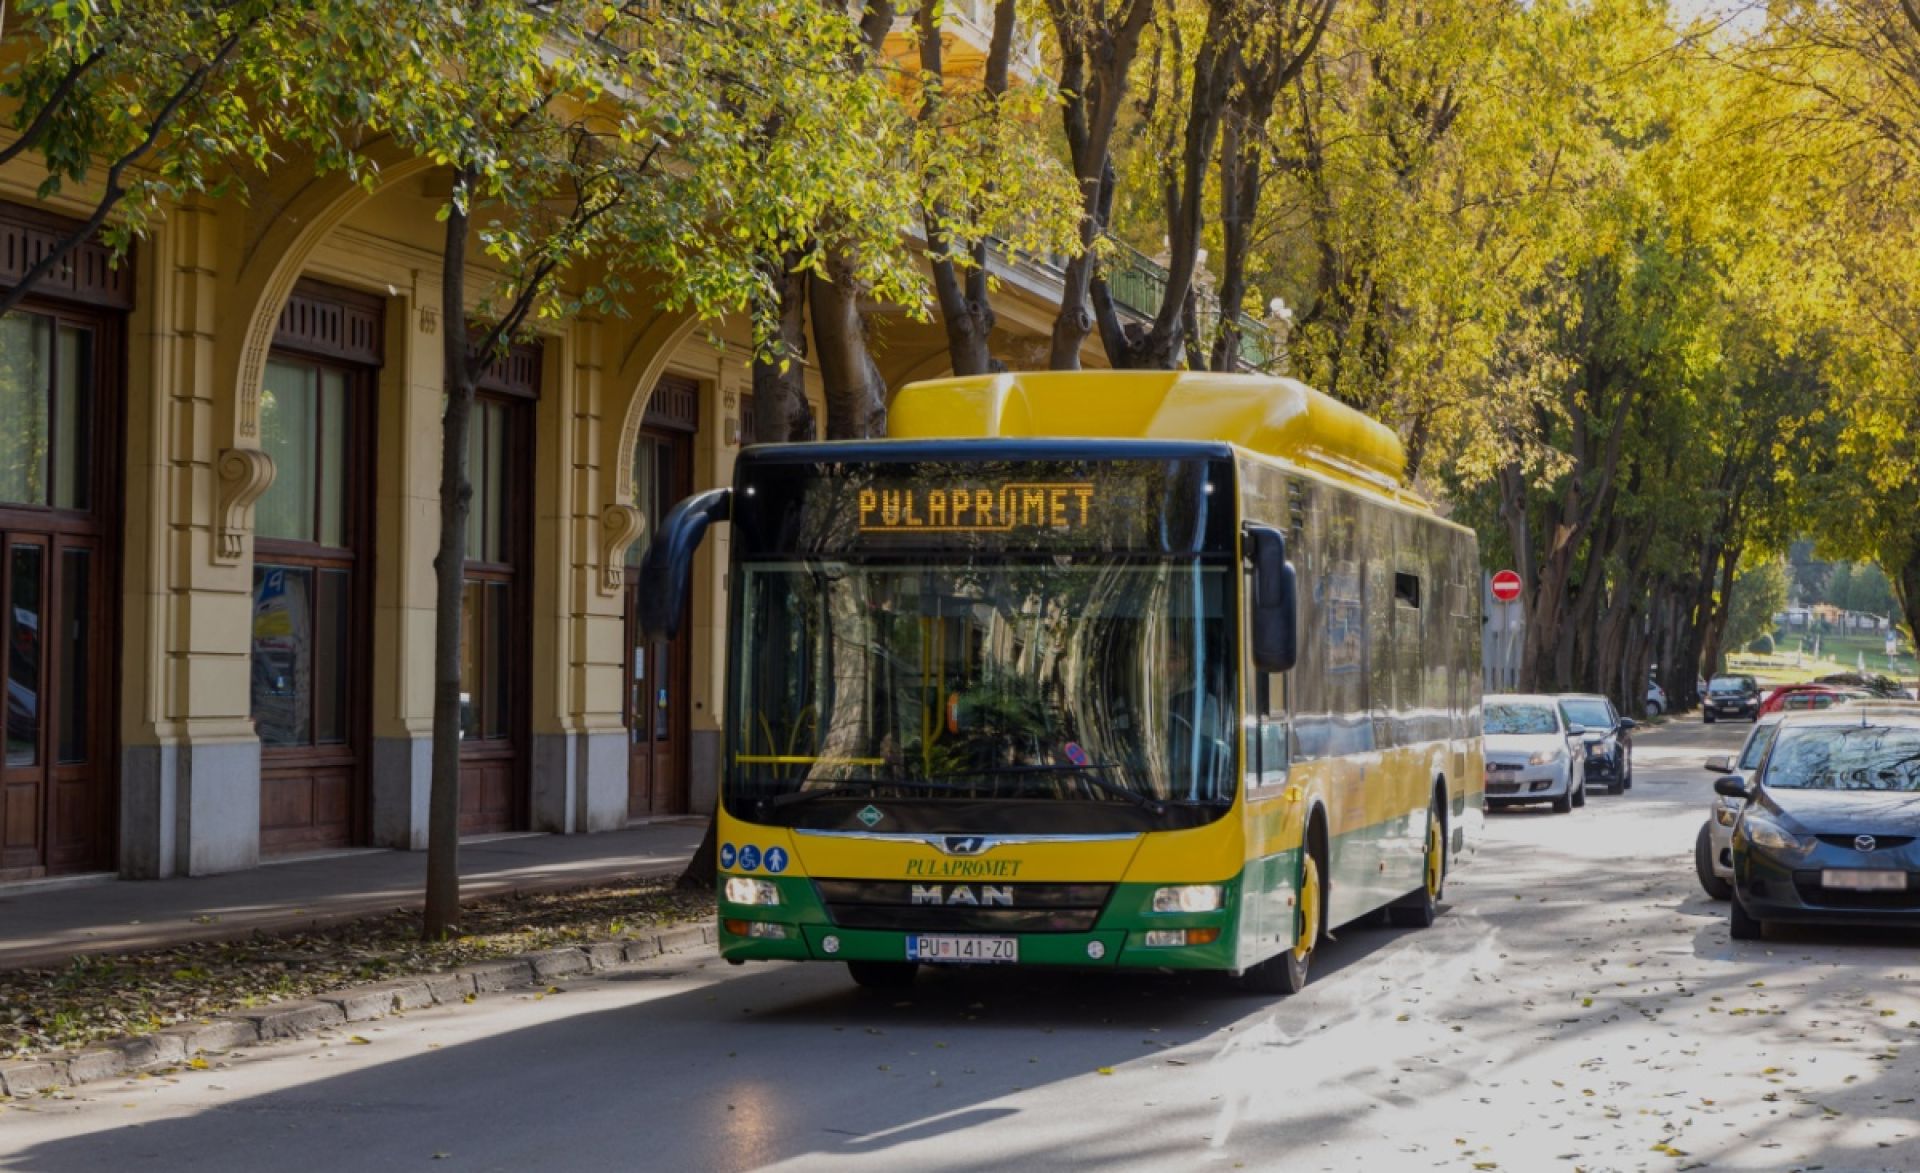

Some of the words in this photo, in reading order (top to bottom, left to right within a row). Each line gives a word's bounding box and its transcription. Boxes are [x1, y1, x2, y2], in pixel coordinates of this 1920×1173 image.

[905, 858, 1021, 877] PULAPROMET
[911, 884, 1014, 905] MAN
[919, 938, 940, 957] PU
